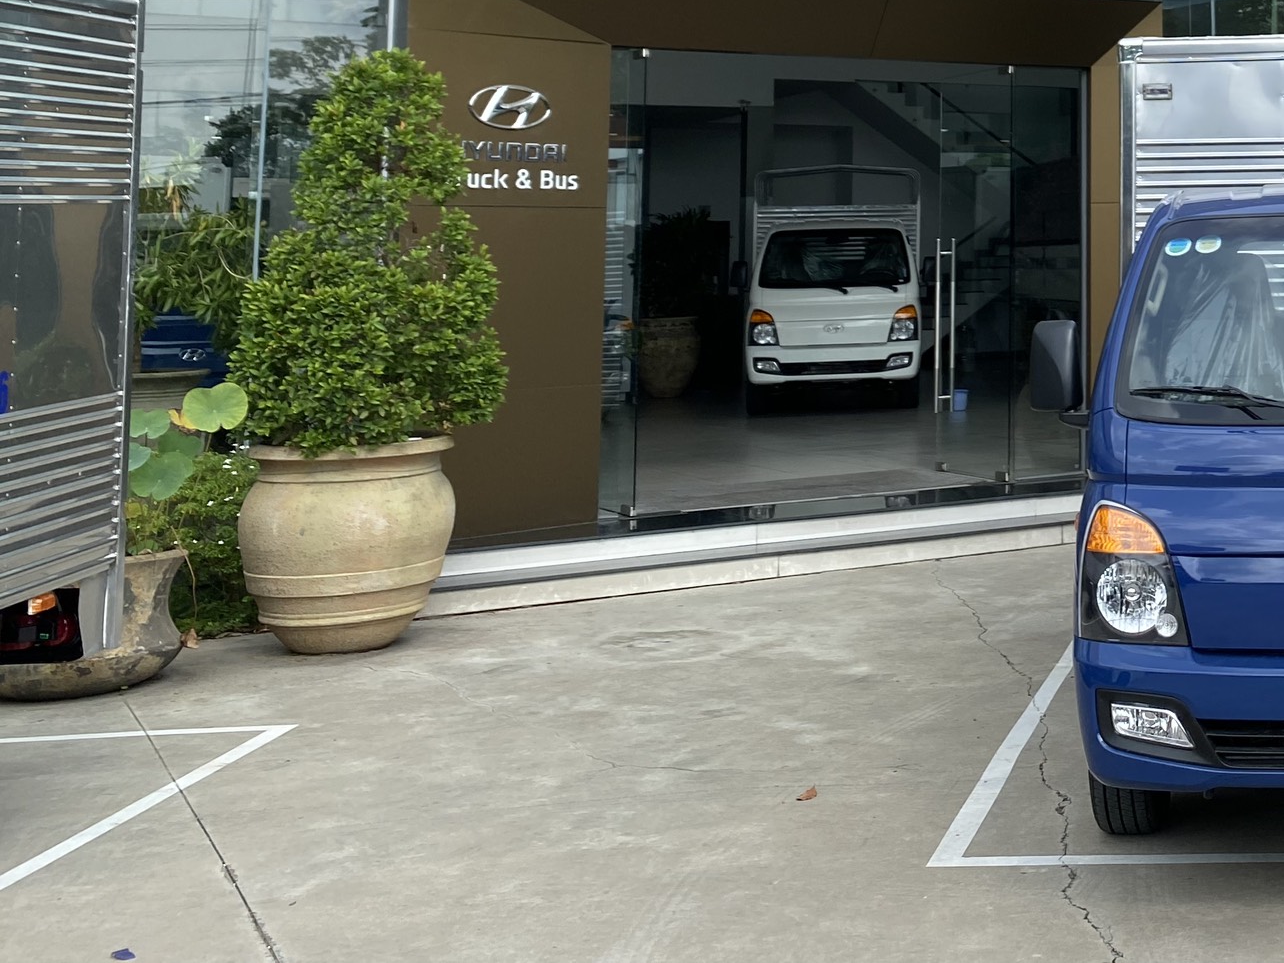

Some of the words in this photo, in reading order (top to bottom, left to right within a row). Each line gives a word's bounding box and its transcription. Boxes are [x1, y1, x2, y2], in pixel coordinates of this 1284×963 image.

[466, 168, 509, 189] uck
[515, 168, 533, 190] &
[540, 169, 579, 190] Bus
